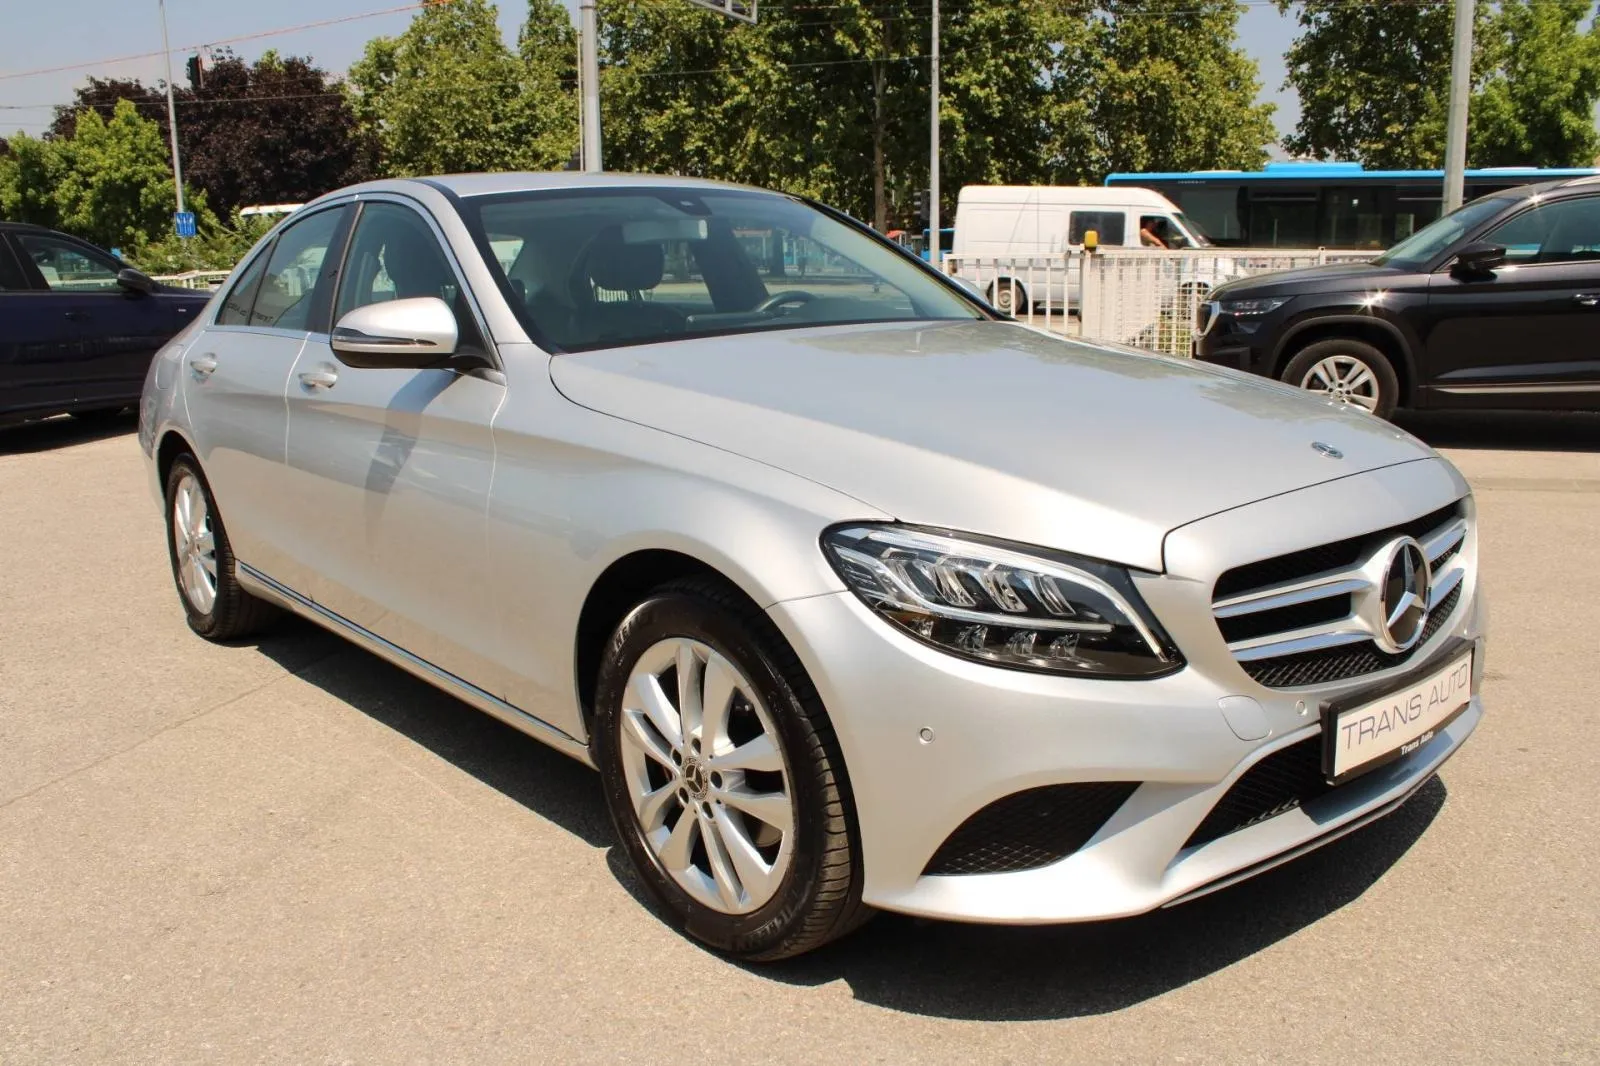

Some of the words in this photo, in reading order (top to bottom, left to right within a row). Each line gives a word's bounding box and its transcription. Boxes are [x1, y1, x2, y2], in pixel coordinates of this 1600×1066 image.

[1342, 694, 1422, 750] TRANS
[1427, 663, 1468, 712] AUTO
[1401, 740, 1420, 755] Trans
[1420, 731, 1434, 744] Auto
